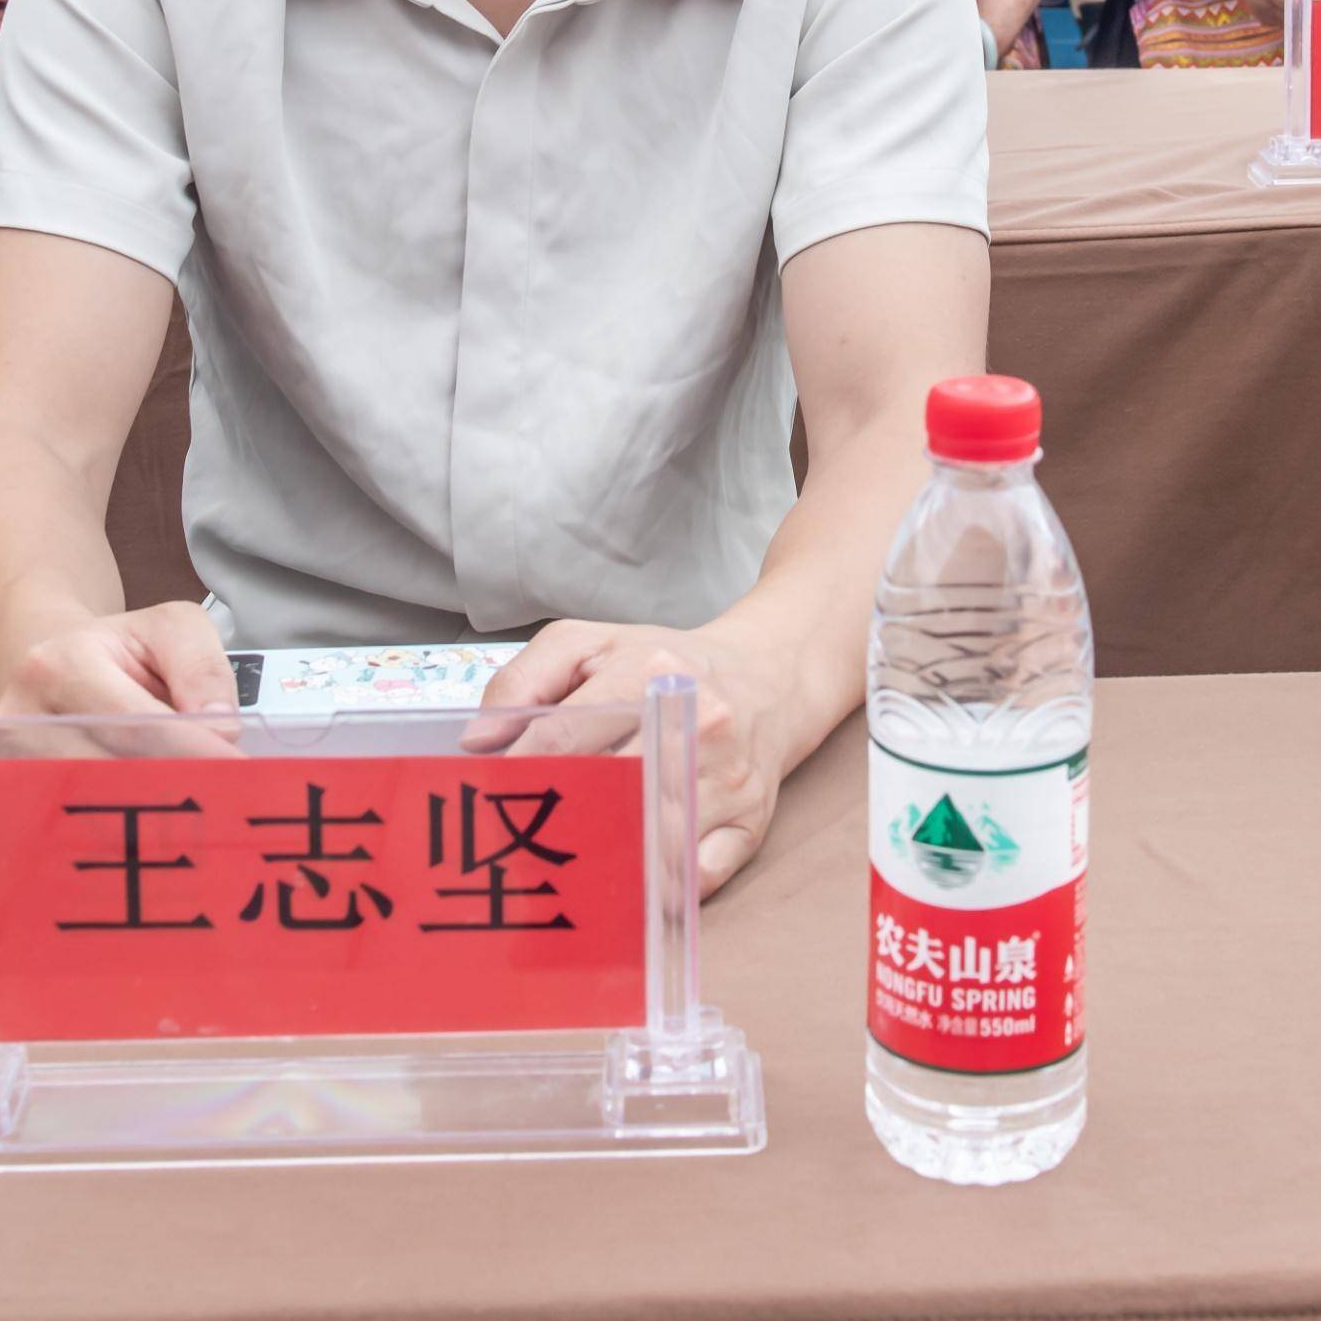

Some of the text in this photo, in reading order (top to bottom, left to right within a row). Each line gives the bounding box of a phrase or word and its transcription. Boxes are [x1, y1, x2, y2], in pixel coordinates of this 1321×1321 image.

[54, 781, 579, 934] 王志坚
[876, 912, 1037, 984] 农夫山泉
[875, 960, 1037, 1012] NONGFU SPRING
